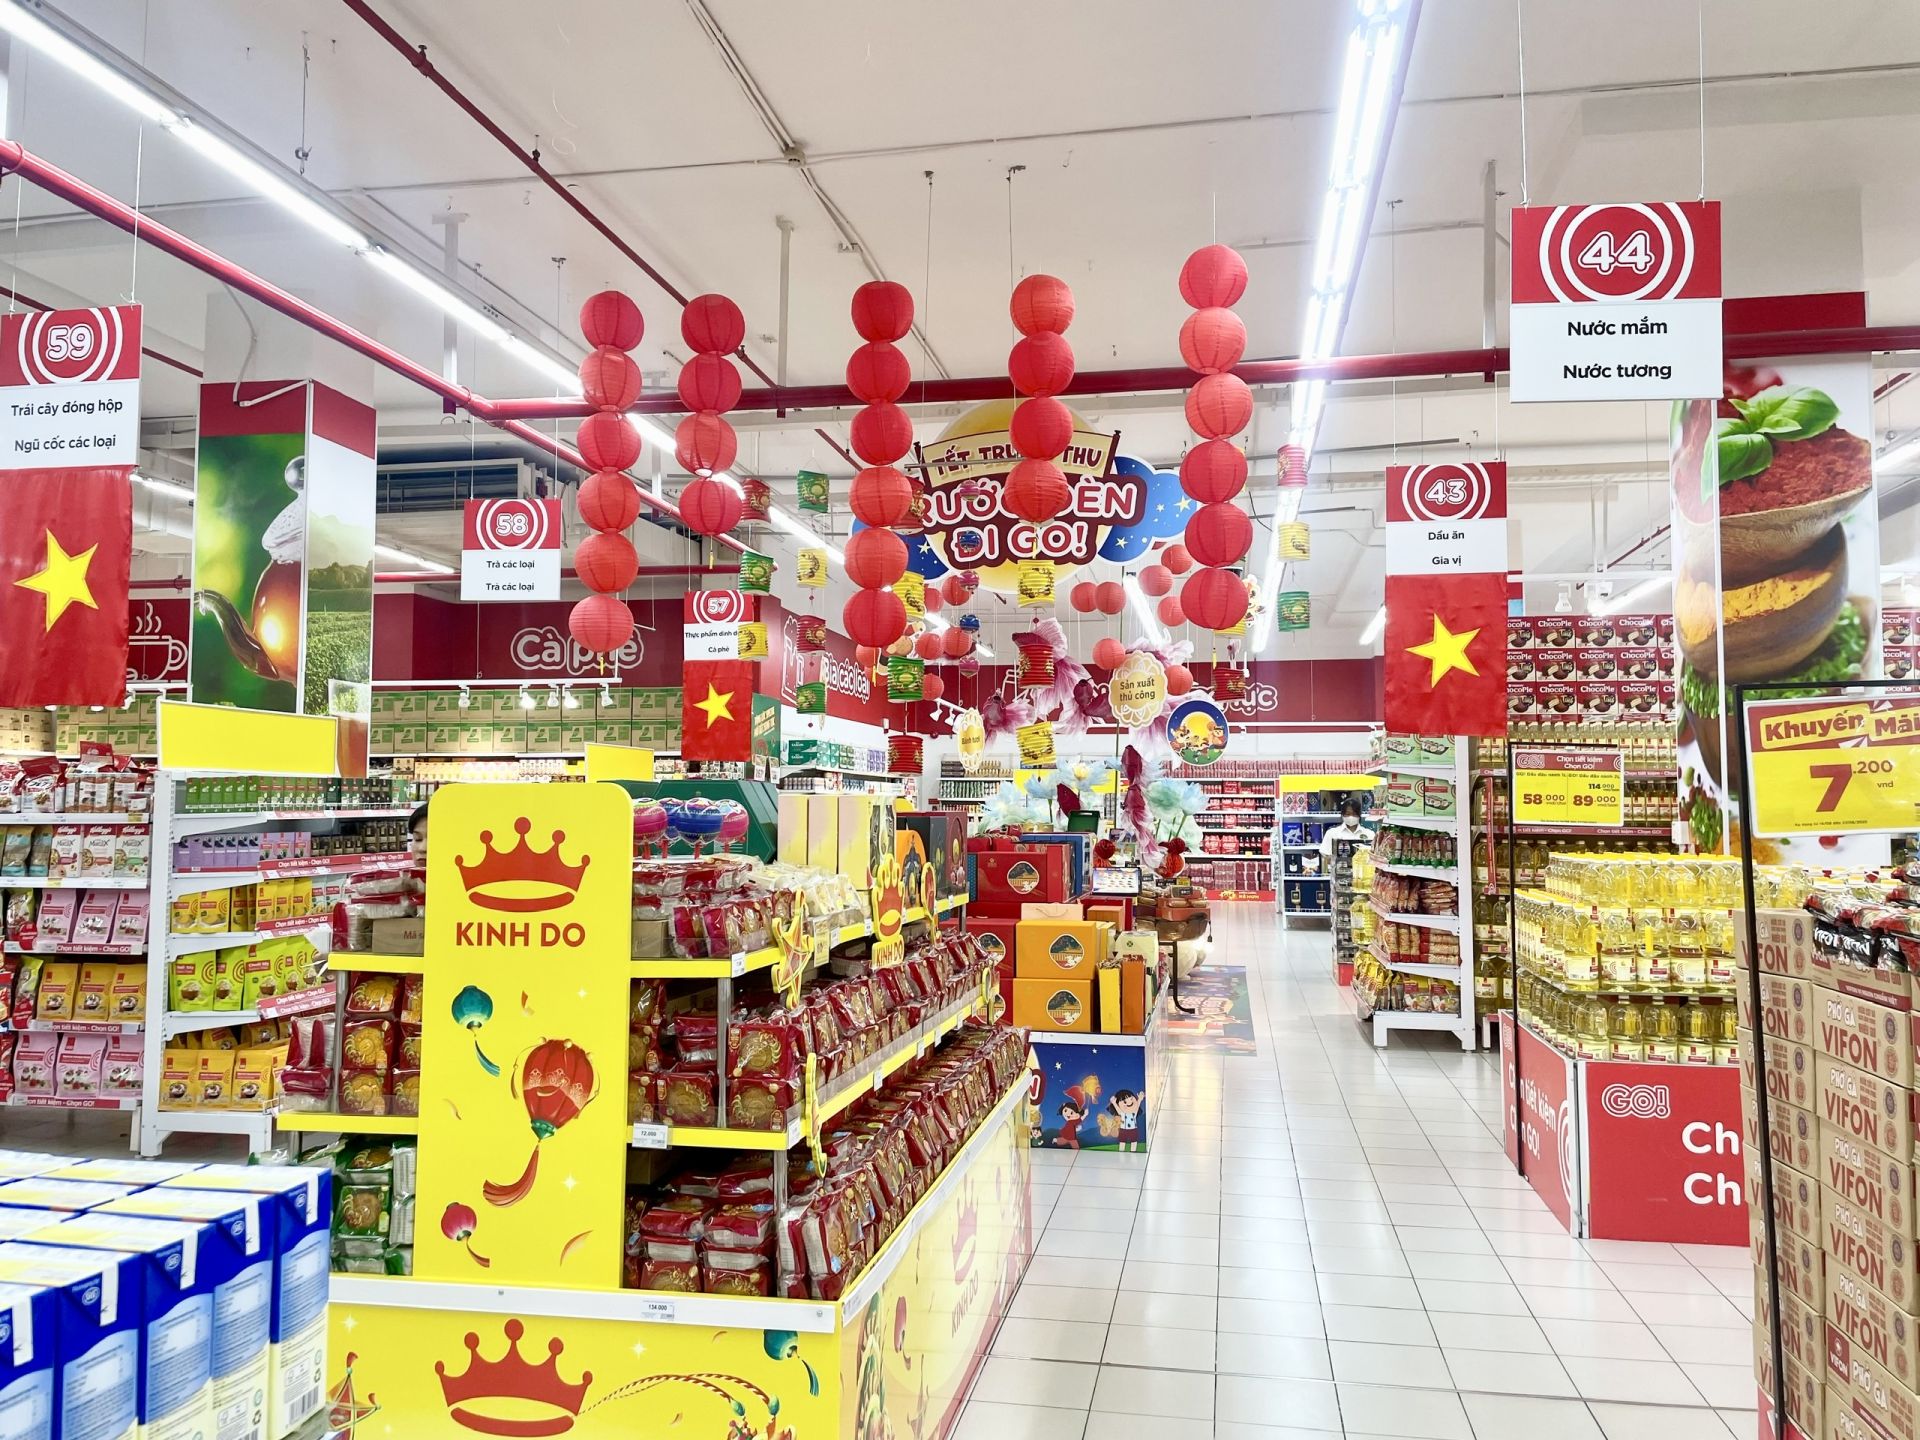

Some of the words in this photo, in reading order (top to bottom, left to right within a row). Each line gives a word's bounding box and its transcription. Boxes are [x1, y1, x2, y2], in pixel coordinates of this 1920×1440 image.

[1578, 230, 1654, 275] 44
[47, 324, 94, 362] 59
[1567, 318, 1616, 337] Nước
[1621, 316, 1668, 335] mắm
[1563, 362, 1612, 380] Nước
[1617, 363, 1672, 381] tương
[11, 403, 34, 417] Trái
[37, 403, 58, 417] cây
[61, 399, 96, 416] đóng
[98, 397, 123, 415] hộp
[14, 437, 41, 453] Ngũ
[43, 434, 66, 450] cốc
[68, 435, 90, 449] các
[92, 434, 117, 450] loại
[1062, 445, 1102, 468] THU
[1425, 479, 1466, 504] 43
[495, 513, 529, 537] 58
[1011, 523, 1087, 558] GO!
[1427, 529, 1449, 541] Dầu
[1451, 530, 1465, 540] ăn
[486, 559, 500, 569] Trà
[500, 559, 517, 570] các
[519, 559, 535, 570] loại
[1431, 555, 1449, 566] Gia
[1451, 555, 1462, 567] vị
[485, 582, 500, 592] Trà
[500, 582, 517, 592] các
[519, 581, 535, 593] loại
[707, 597, 731, 614] 57
[685, 631, 700, 640] Thực
[700, 629, 718, 639] phẩm
[719, 630, 733, 638] dinh
[1507, 620, 1531, 628] ocoPie
[514, 628, 563, 665] Cà
[1119, 680, 1134, 690] Sản
[1136, 676, 1155, 689] xuất
[1119, 689, 1133, 701] thủ
[1134, 689, 1156, 701] công
[1765, 709, 1865, 742] Khuyến
[1875, 713, 1920, 736] Mãi
[1556, 755, 1574, 764] Chọn
[1575, 755, 1586, 763] tiết
[1586, 756, 1603, 764] kiệm
[1564, 762, 1581, 770] Chọn
[1810, 759, 1894, 812] 7.200
[1876, 780, 1894, 788] vnd
[56, 945, 72, 954] Chọn
[455, 921, 530, 947] KINH
[540, 921, 586, 948] DO
[1741, 940, 1788, 974] VFON
[1743, 1001, 1788, 1038] VON
[1821, 1021, 1877, 1073] VIFON
[1745, 1060, 1789, 1101] VON
[1525, 1078, 1538, 1114] tiết
[1537, 1087, 1557, 1134] kiệm
[1602, 1083, 1671, 1119] GO!
[1824, 1088, 1878, 1146] VIFON
[1526, 1121, 1541, 1161] GO!
[1681, 1121, 1740, 1156] Ch
[1748, 1118, 1792, 1165] VON
[1683, 1171, 1742, 1207] Ch
[1830, 1156, 1883, 1219] VIFON
[1755, 1236, 1798, 1293] VON
[1830, 1222, 1884, 1291] VIFON
[951, 1286, 969, 1339] KINH
[969, 1268, 979, 1305] DO
[1760, 1298, 1801, 1361] VON
[1834, 1291, 1888, 1367] VIFON
[1829, 1351, 1849, 1377] VIFON
